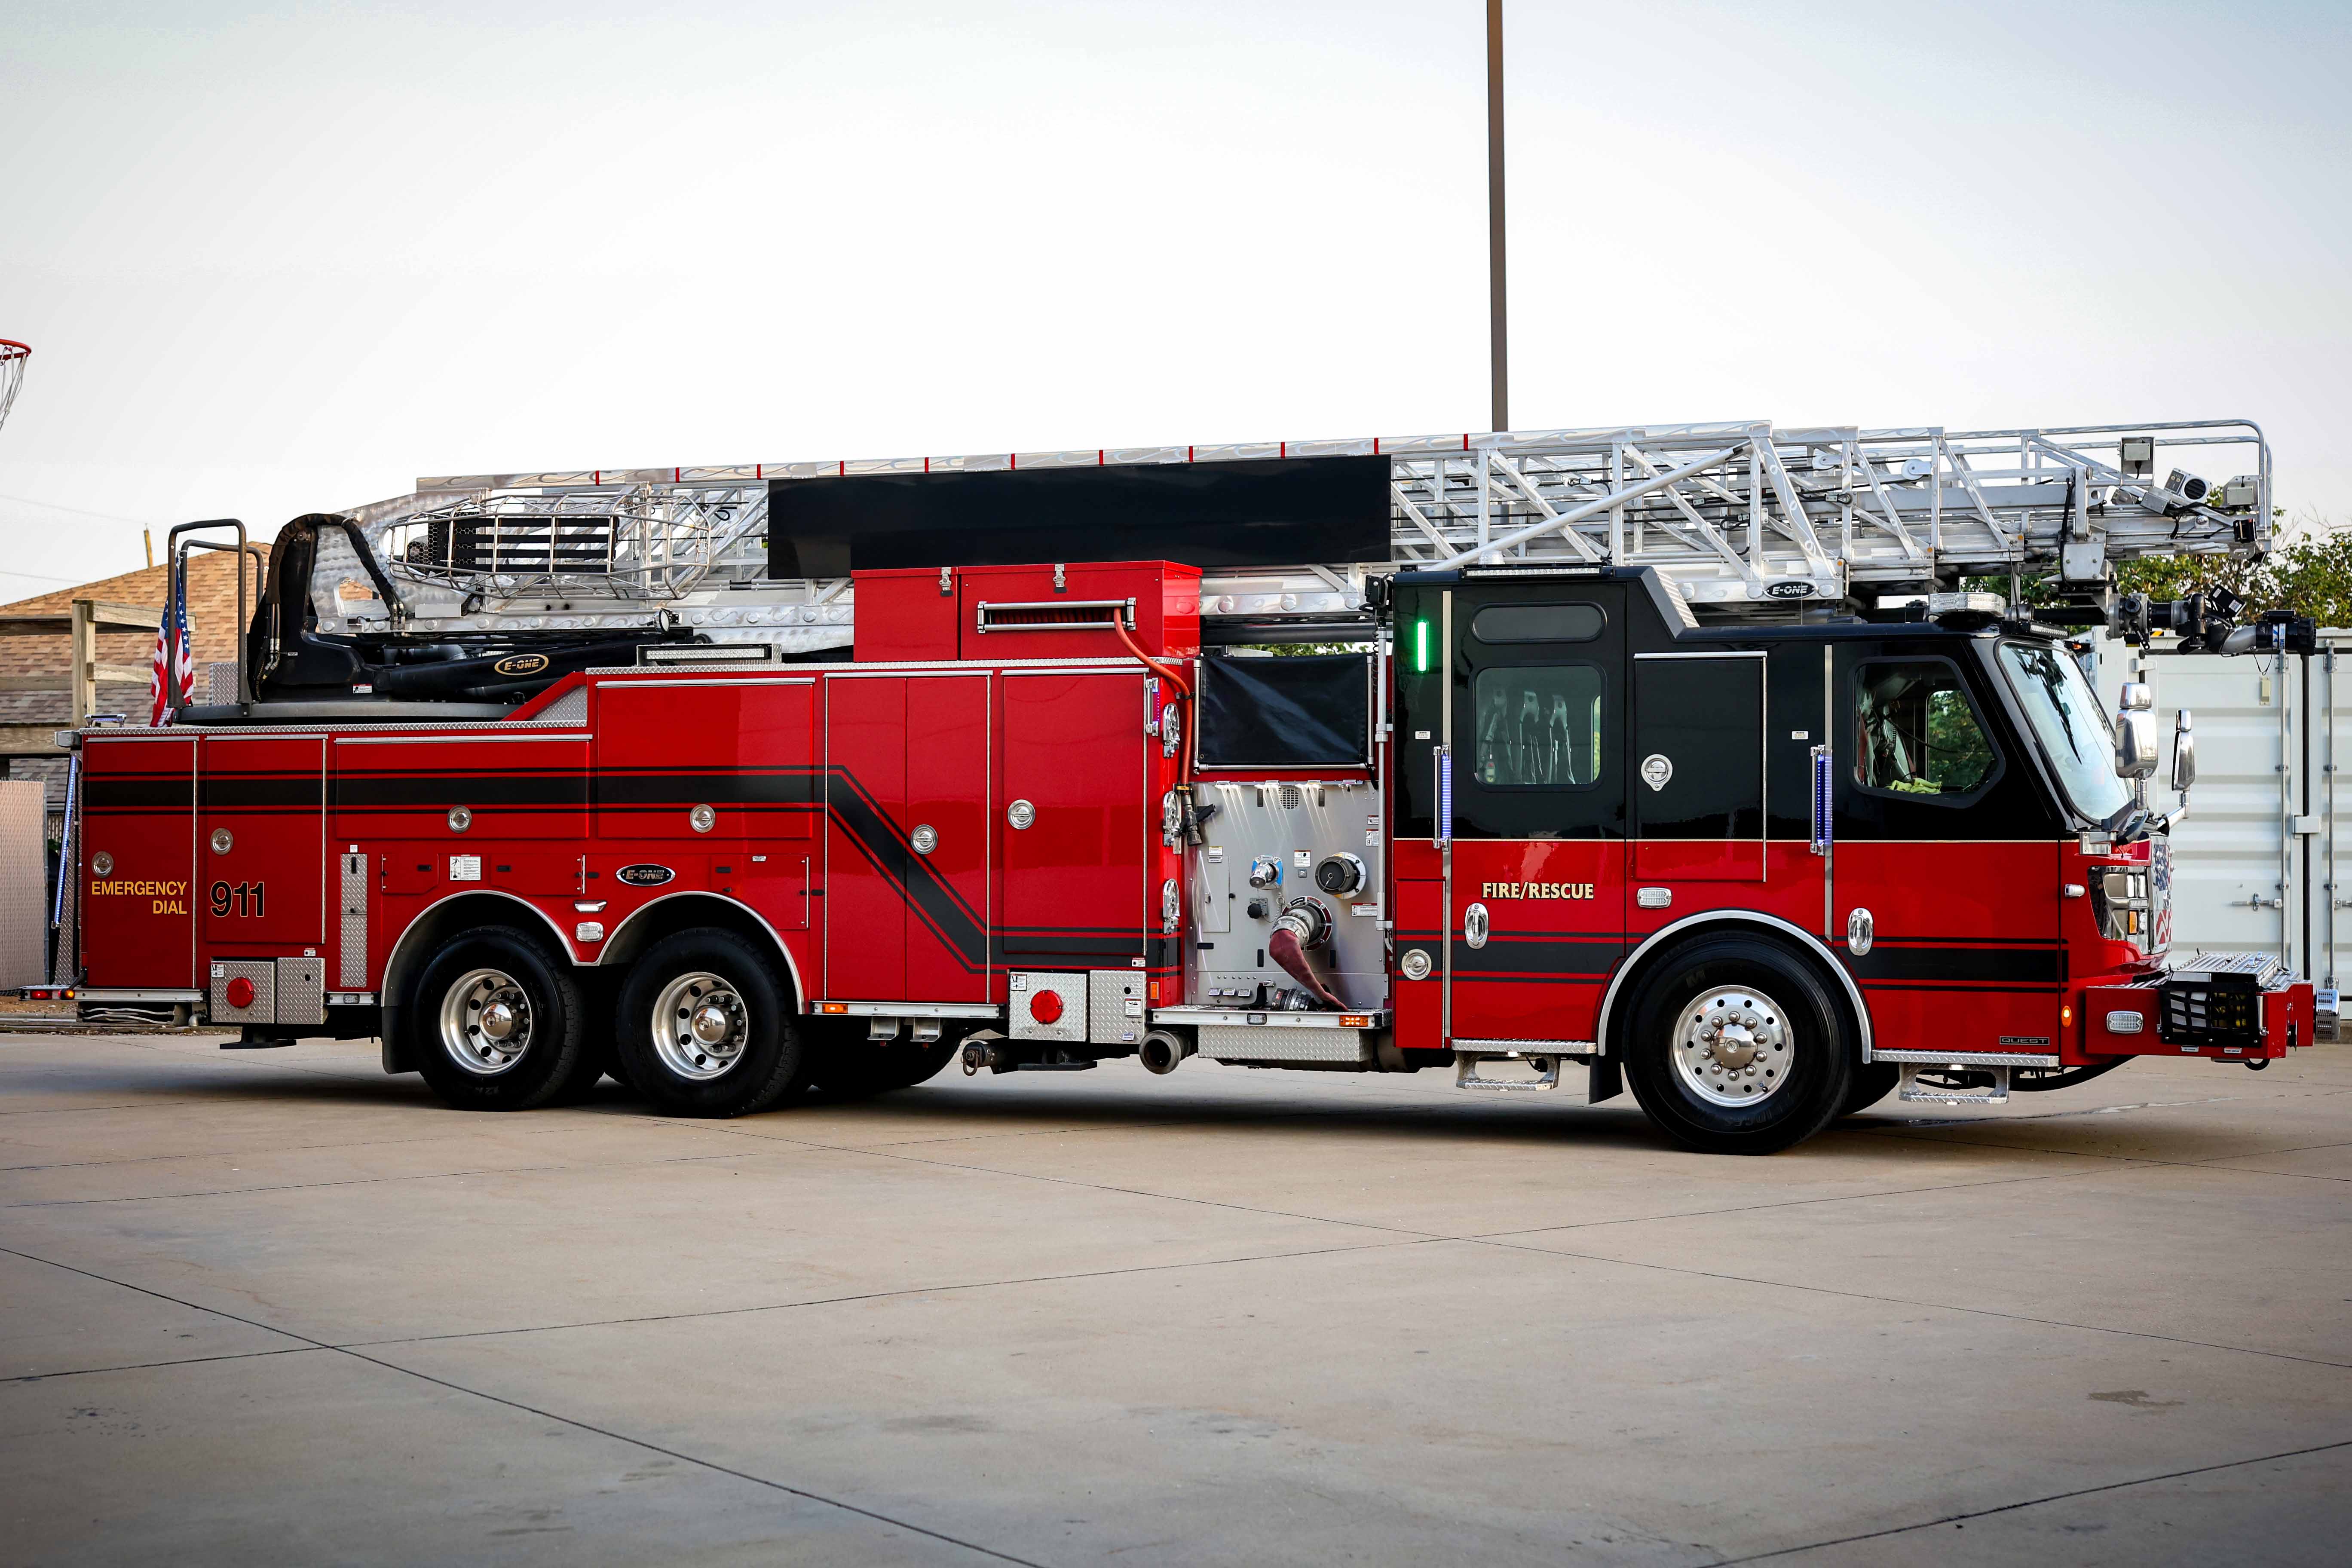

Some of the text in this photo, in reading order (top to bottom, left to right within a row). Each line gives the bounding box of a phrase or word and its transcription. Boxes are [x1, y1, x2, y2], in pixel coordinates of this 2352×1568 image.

[1772, 585, 1808, 595] E-ONE
[504, 658, 540, 671] E-ONE
[625, 870, 664, 880] E-ONE
[92, 881, 187, 895] EMERGENCY
[1482, 881, 1594, 900] FIRE/RESCUE
[210, 880, 264, 918] 911
[153, 900, 187, 914] DIAL
